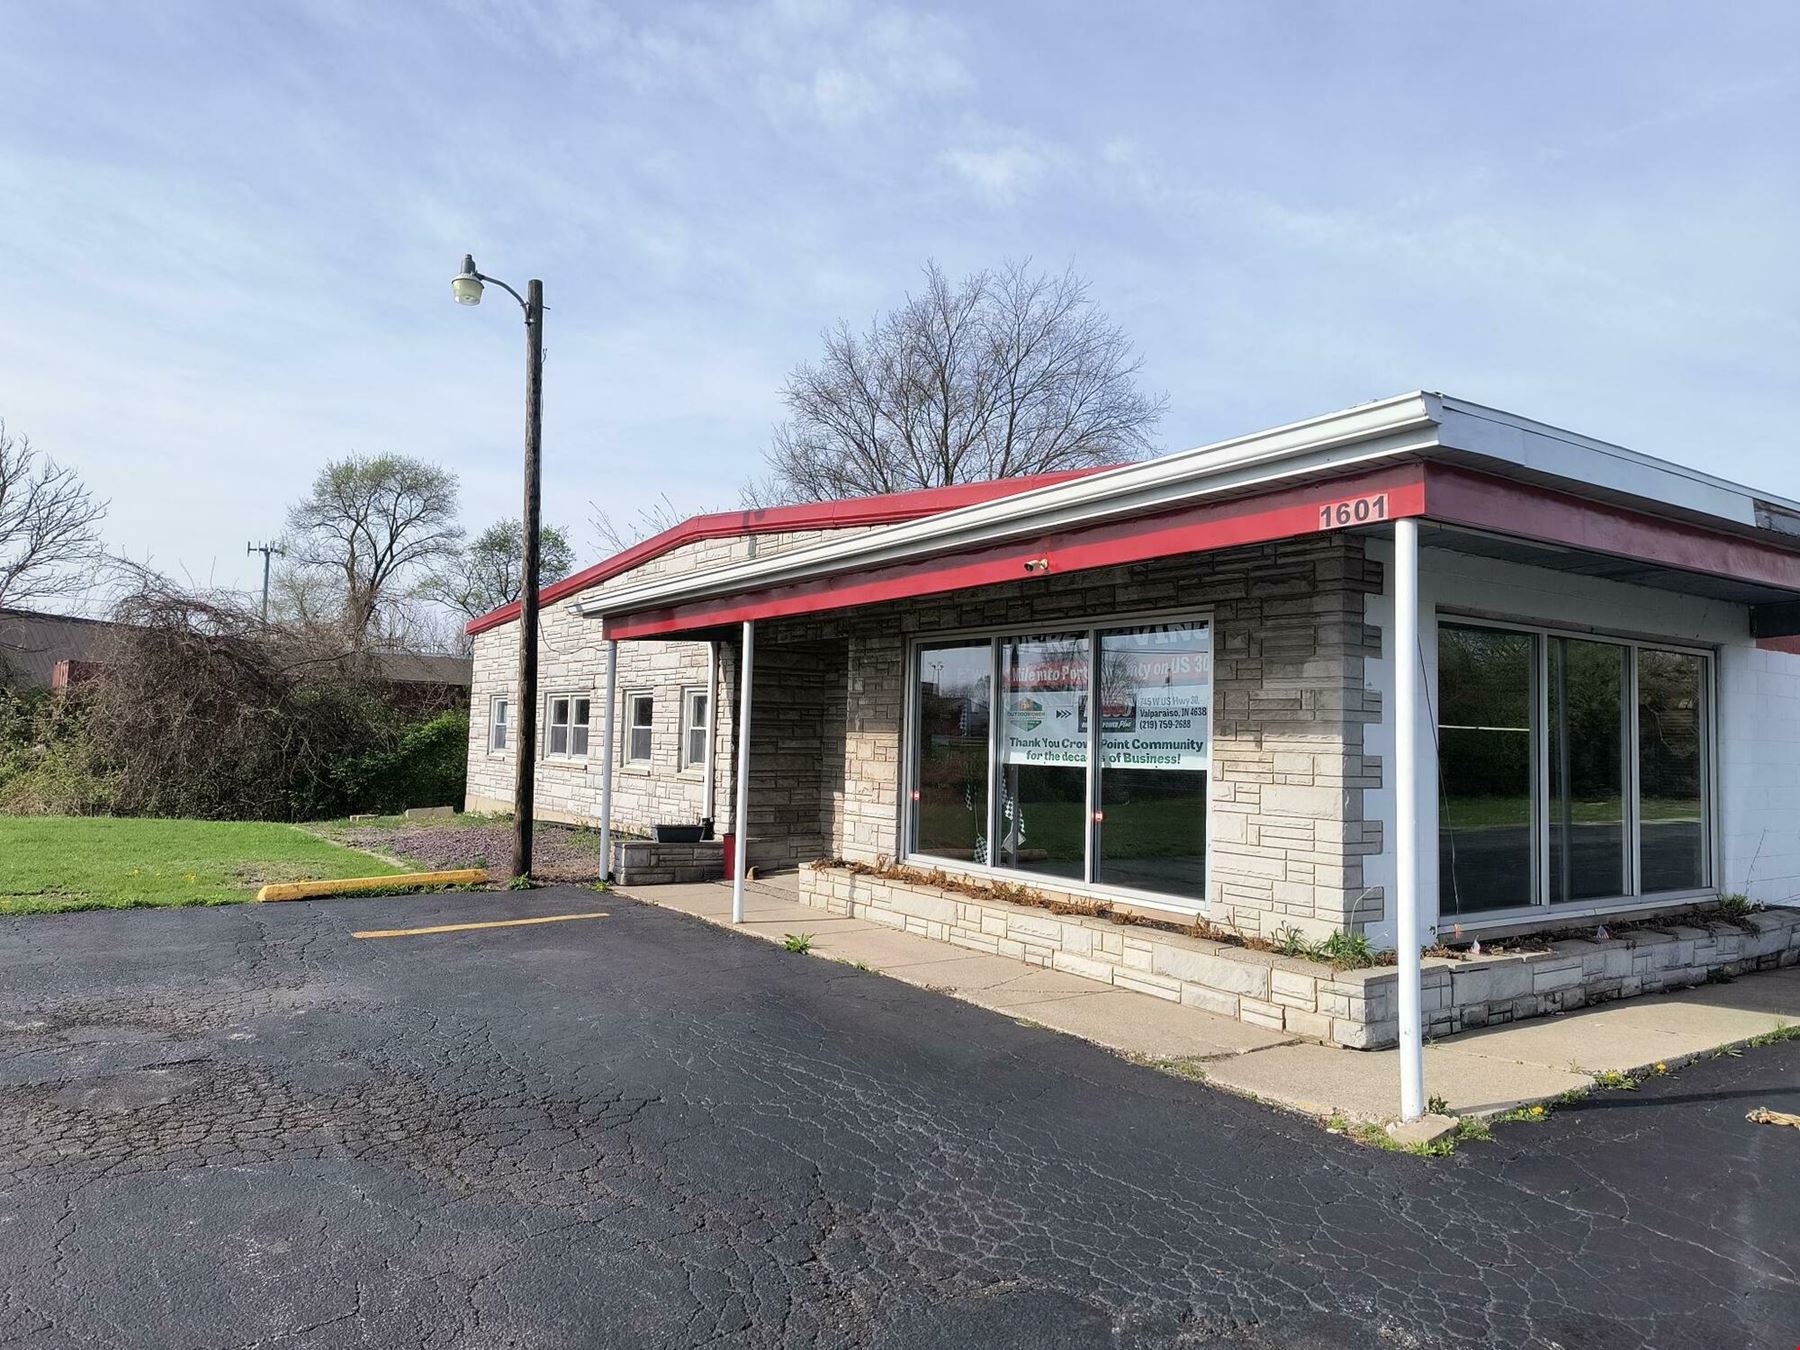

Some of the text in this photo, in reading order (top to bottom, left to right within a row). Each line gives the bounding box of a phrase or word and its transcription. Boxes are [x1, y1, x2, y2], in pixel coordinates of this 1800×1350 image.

[1321, 496, 1384, 528] 1601
[1012, 667, 1035, 682] Mile
[1037, 667, 1060, 681] into
[1153, 662, 1168, 675] on
[1171, 656, 1190, 674] US
[1194, 655, 1208, 672] 30
[1152, 697, 1160, 706] W
[1162, 697, 1171, 706] US
[1172, 697, 1190, 707] Hwy
[1140, 708, 1181, 719] Valparaiso,
[1182, 708, 1190, 717] IN
[1139, 719, 1191, 730] (219) 759-2688
[1009, 737, 1041, 748] Thank
[1042, 737, 1060, 748] You
[1131, 739, 1204, 752] Community
[1026, 750, 1043, 760] for
[1044, 751, 1061, 762] the
[1109, 753, 1121, 763] of
[1123, 752, 1181, 764] Business!
